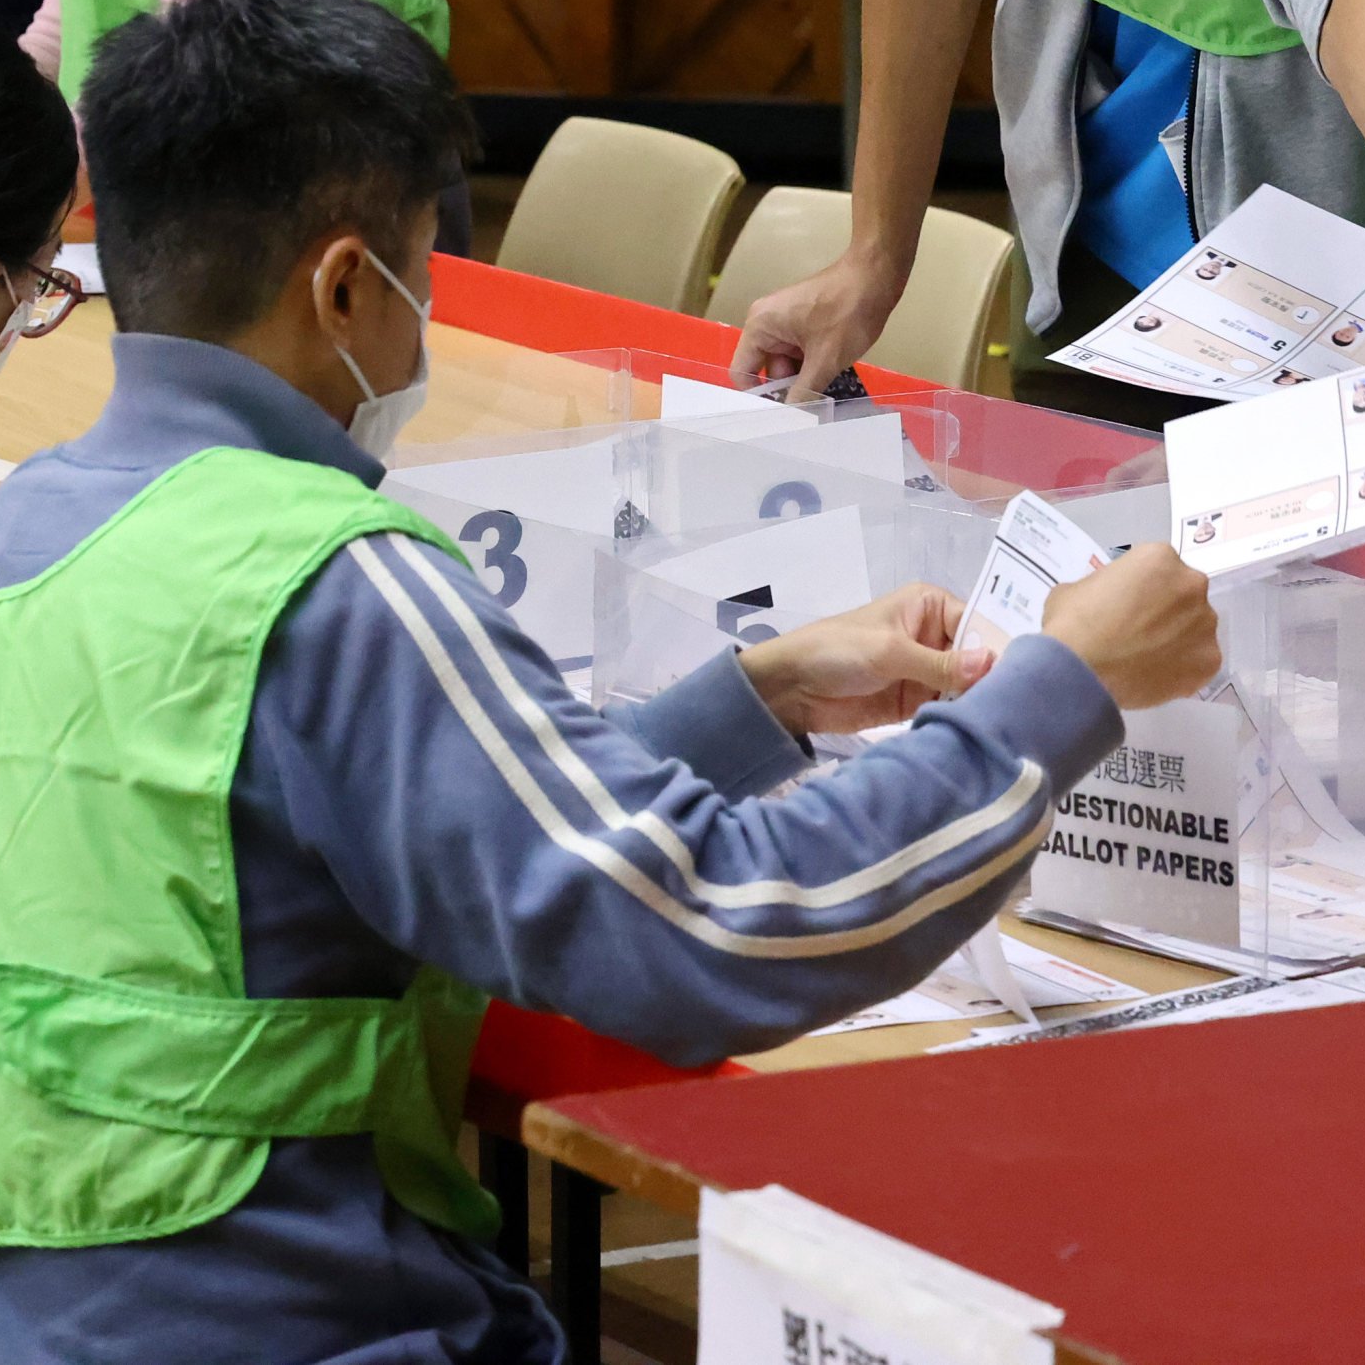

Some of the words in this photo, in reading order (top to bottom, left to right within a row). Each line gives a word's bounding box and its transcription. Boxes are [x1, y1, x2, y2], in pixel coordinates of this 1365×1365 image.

[458, 509, 528, 609] 3
[990, 574, 1000, 594] 1
[1094, 746, 1186, 793] 題選票
[1057, 792, 1230, 845] UESTIONABLE
[1137, 846, 1235, 887] PAPERS
